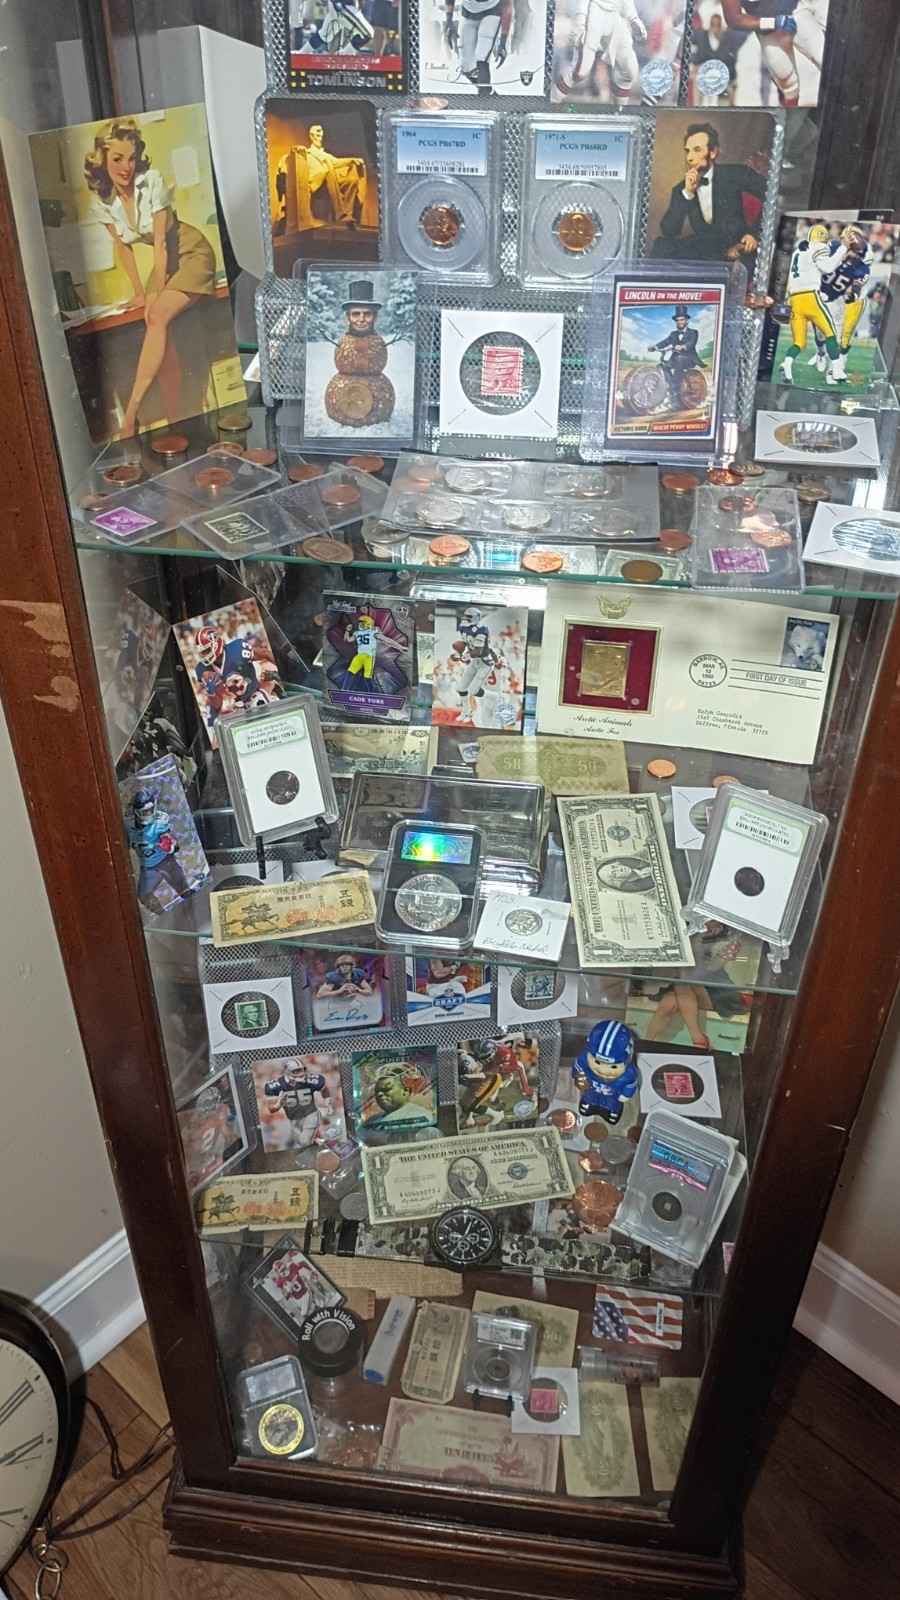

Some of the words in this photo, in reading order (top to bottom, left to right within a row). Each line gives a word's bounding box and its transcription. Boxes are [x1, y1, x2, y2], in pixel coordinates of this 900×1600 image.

[307, 74, 386, 88] TOMLINSON
[791, 253, 800, 278] 4
[624, 291, 656, 300] LINCOLN
[678, 292, 703, 300] MOVE!
[788, 678, 808, 686] ISSUE
[574, 714, 596, 722] Arctic
[598, 716, 632, 726] Animals
[578, 820, 588, 850] AMERICA
[582, 850, 590, 859] OF
[648, 844, 662, 884] DOLLAR
[584, 860, 594, 886] STATES
[587, 887, 599, 915] UNITED
[657, 884, 666, 906] ONE
[592, 916, 601, 933] THE
[435, 998, 464, 1006] DRAFT
[398, 1154, 416, 1163] THE
[418, 1152, 448, 1160] UNITED
[448, 1148, 476, 1156] STATES
[489, 1140, 526, 1150] AMERICA
[302, 1322, 314, 1340] Roll
[312, 1310, 330, 1323] with
[334, 1308, 356, 1330] Vision
[443, 1447, 460, 1457] TEN
